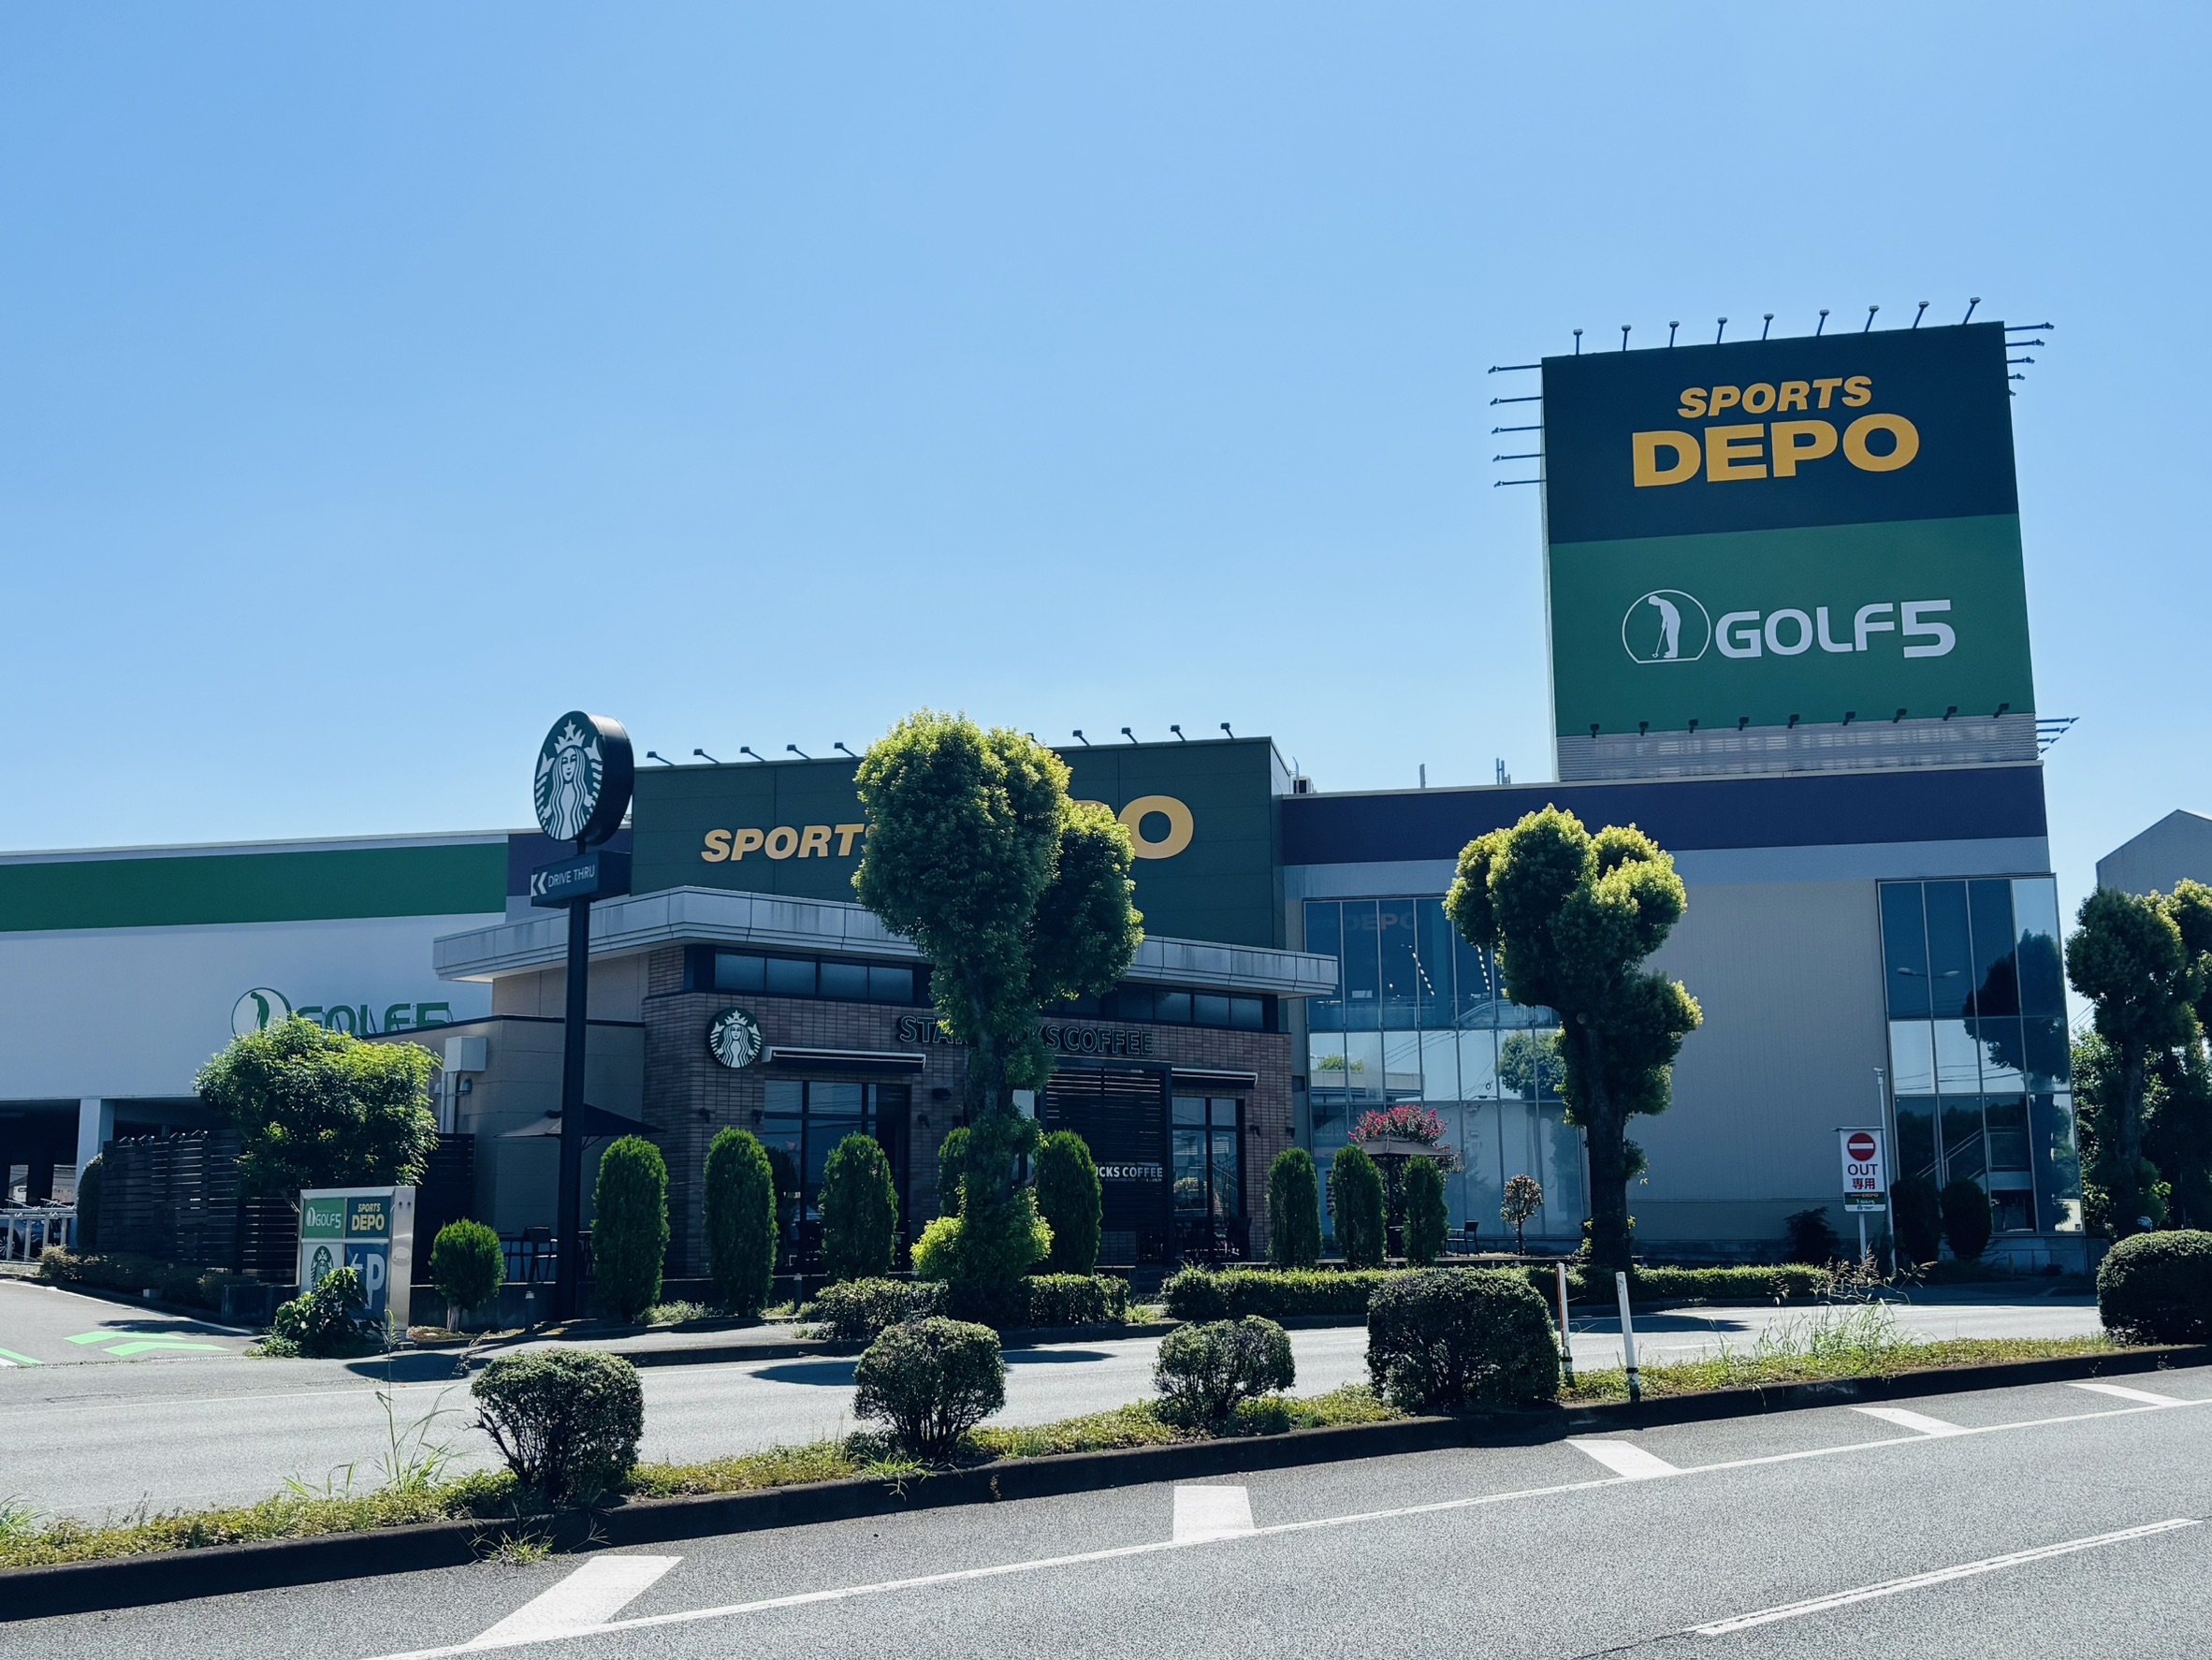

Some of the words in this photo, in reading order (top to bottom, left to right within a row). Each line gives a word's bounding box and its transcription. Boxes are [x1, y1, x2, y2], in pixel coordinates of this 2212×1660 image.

[1677, 375, 1872, 418] SPORTS
[1632, 414, 1919, 488] DEPO
[1715, 600, 1957, 659] GOLF5
[548, 870, 572, 888] DRIVE
[573, 865, 595, 881] THRU
[1063, 1026, 1155, 1056] COFFEE
[1122, 1167, 1163, 1178] COFFEE
[1847, 1163, 1878, 1176] OUT
[1852, 1177, 1875, 1190] 専用
[358, 1202, 381, 1213] SPORTS
[315, 1213, 342, 1229] GOLF5
[352, 1214, 386, 1230] DEPO
[365, 1254, 386, 1309] P
